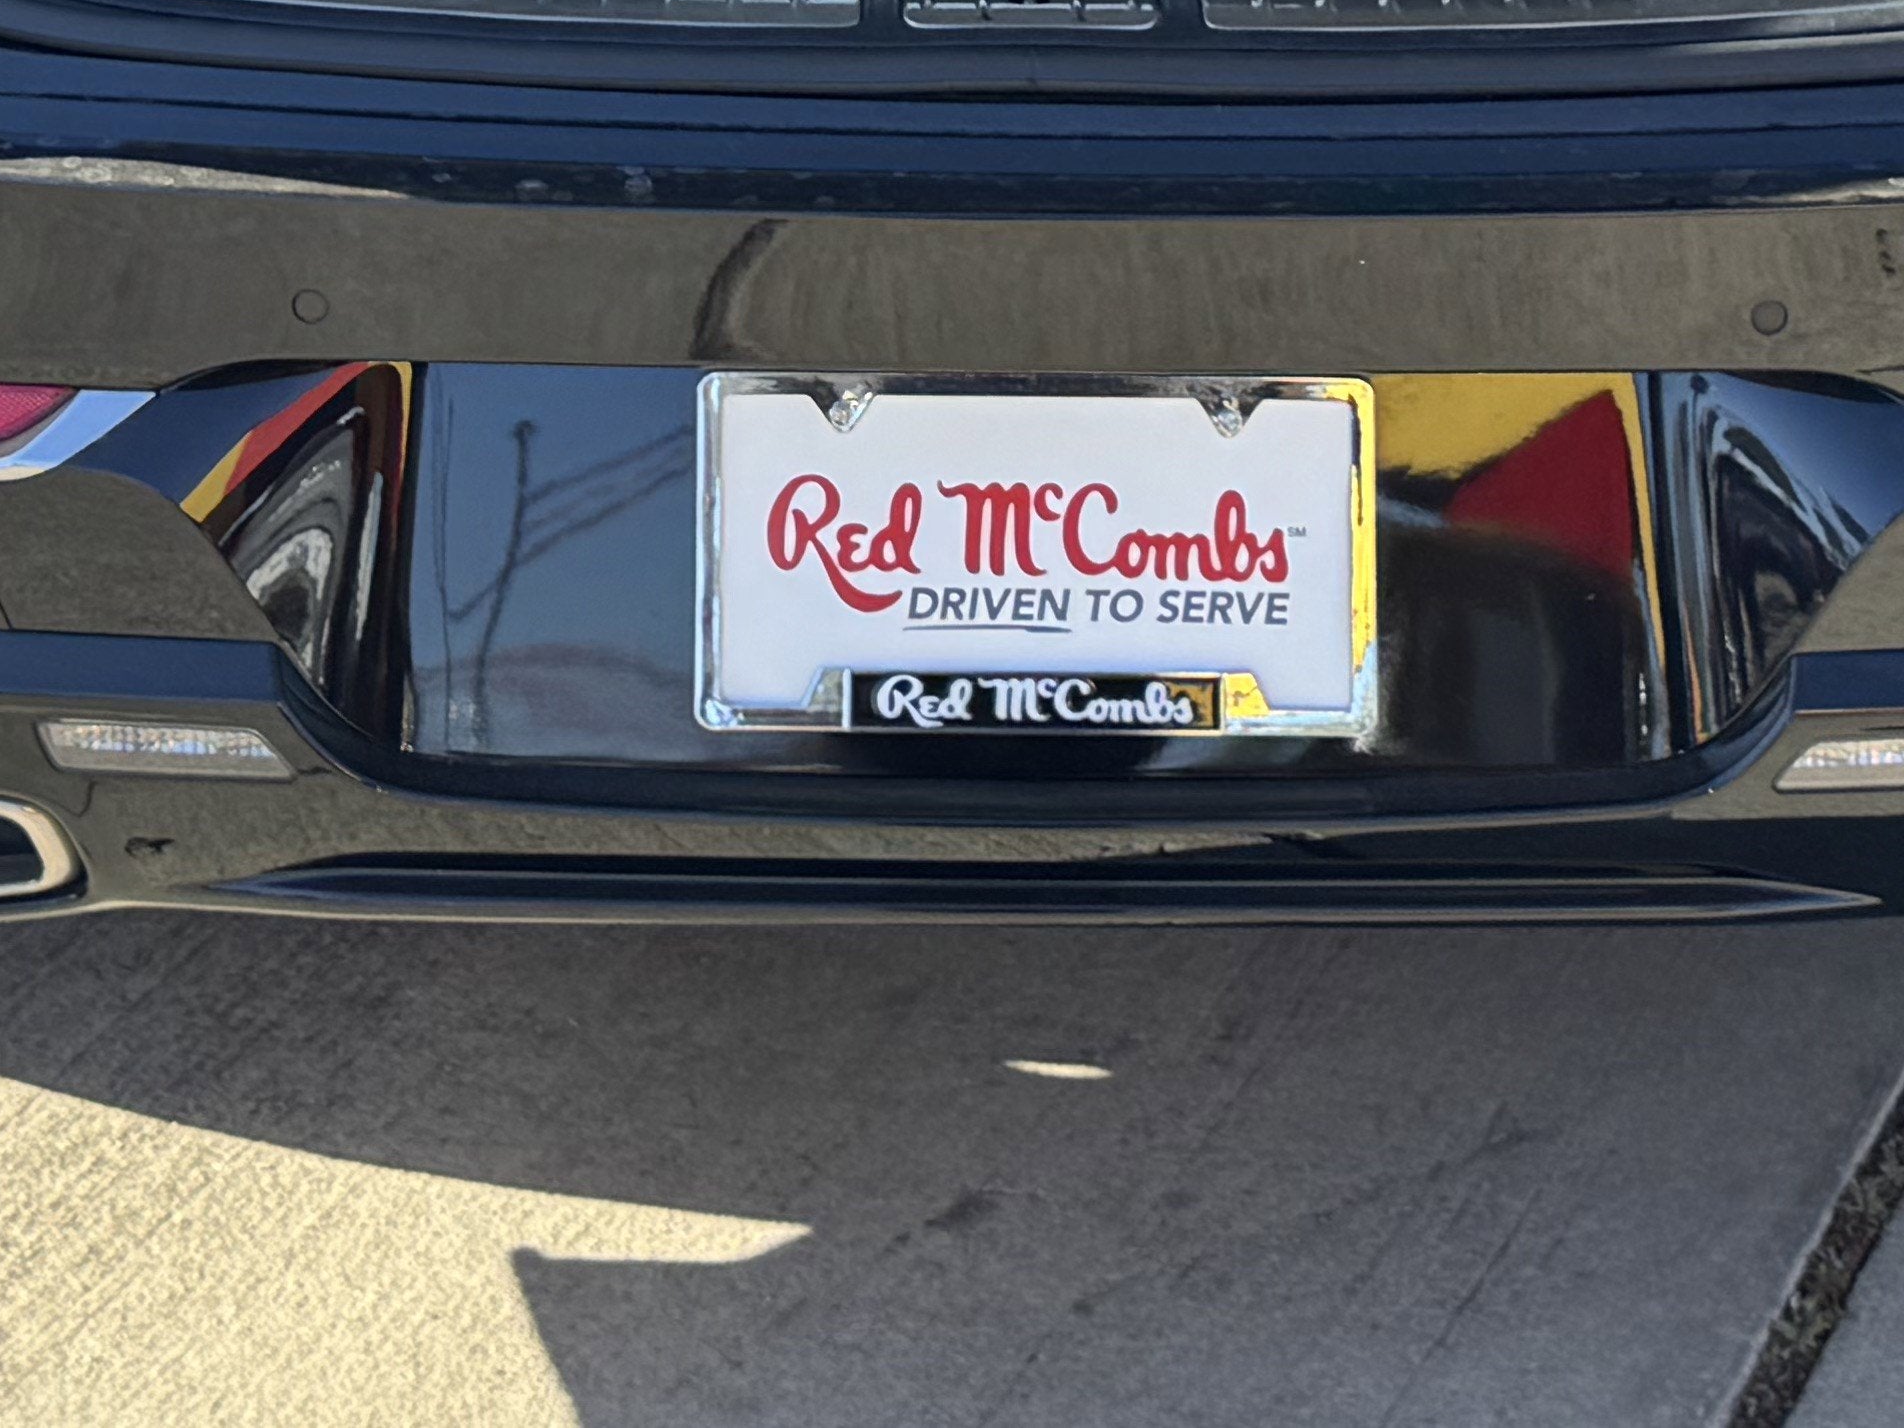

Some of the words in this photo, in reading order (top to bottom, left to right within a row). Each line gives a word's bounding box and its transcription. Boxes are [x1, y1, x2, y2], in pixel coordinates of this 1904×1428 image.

[767, 474, 923, 614] Red
[938, 479, 1290, 584] McCombs
[908, 587, 1072, 622] DRIVEN
[1085, 589, 1144, 624] TO
[1156, 590, 1291, 626] SERVE
[876, 674, 974, 729] Red
[977, 677, 1194, 725] McCombs
